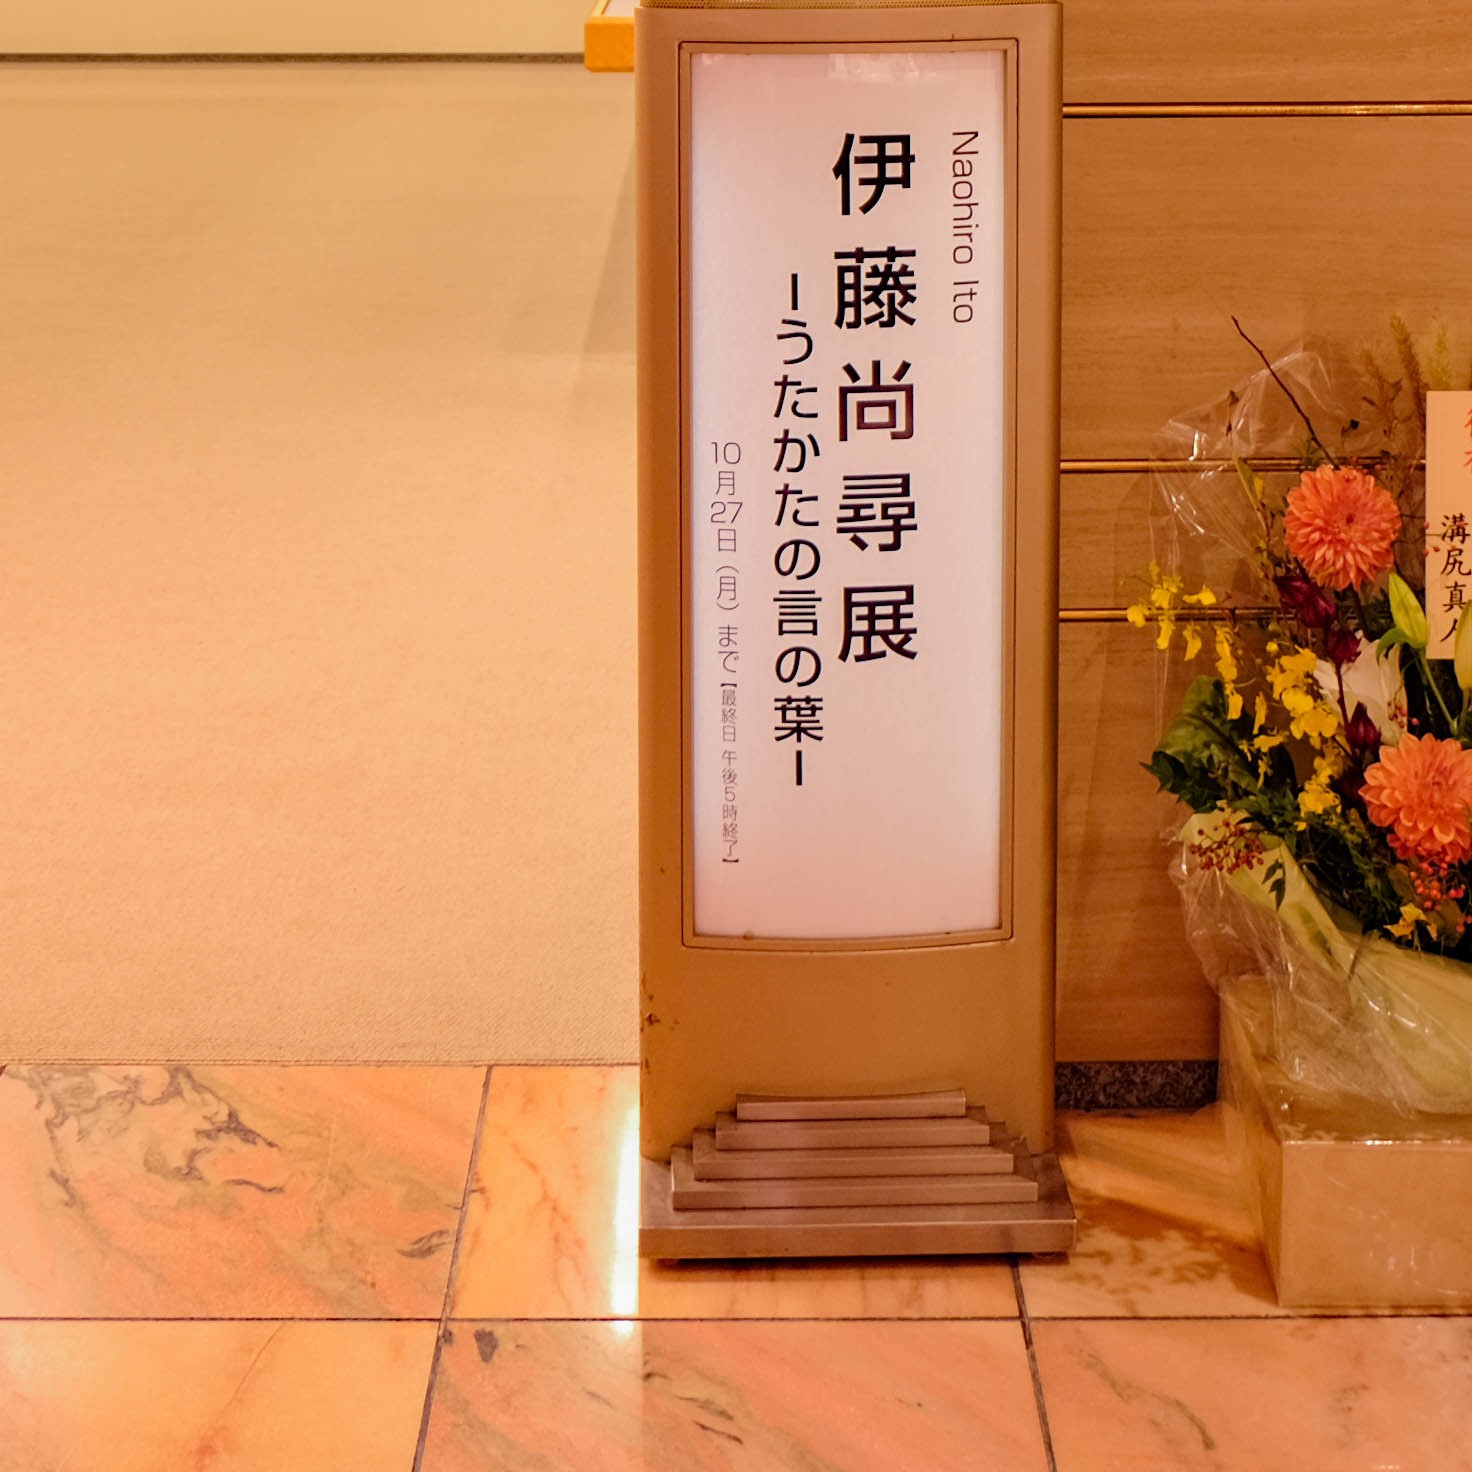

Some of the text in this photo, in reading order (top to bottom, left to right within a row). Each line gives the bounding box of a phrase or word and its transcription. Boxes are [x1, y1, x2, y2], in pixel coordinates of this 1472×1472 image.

[831, 132, 918, 664] 伊藤尚尋展
[952, 131, 979, 324] Naohiro Ito
